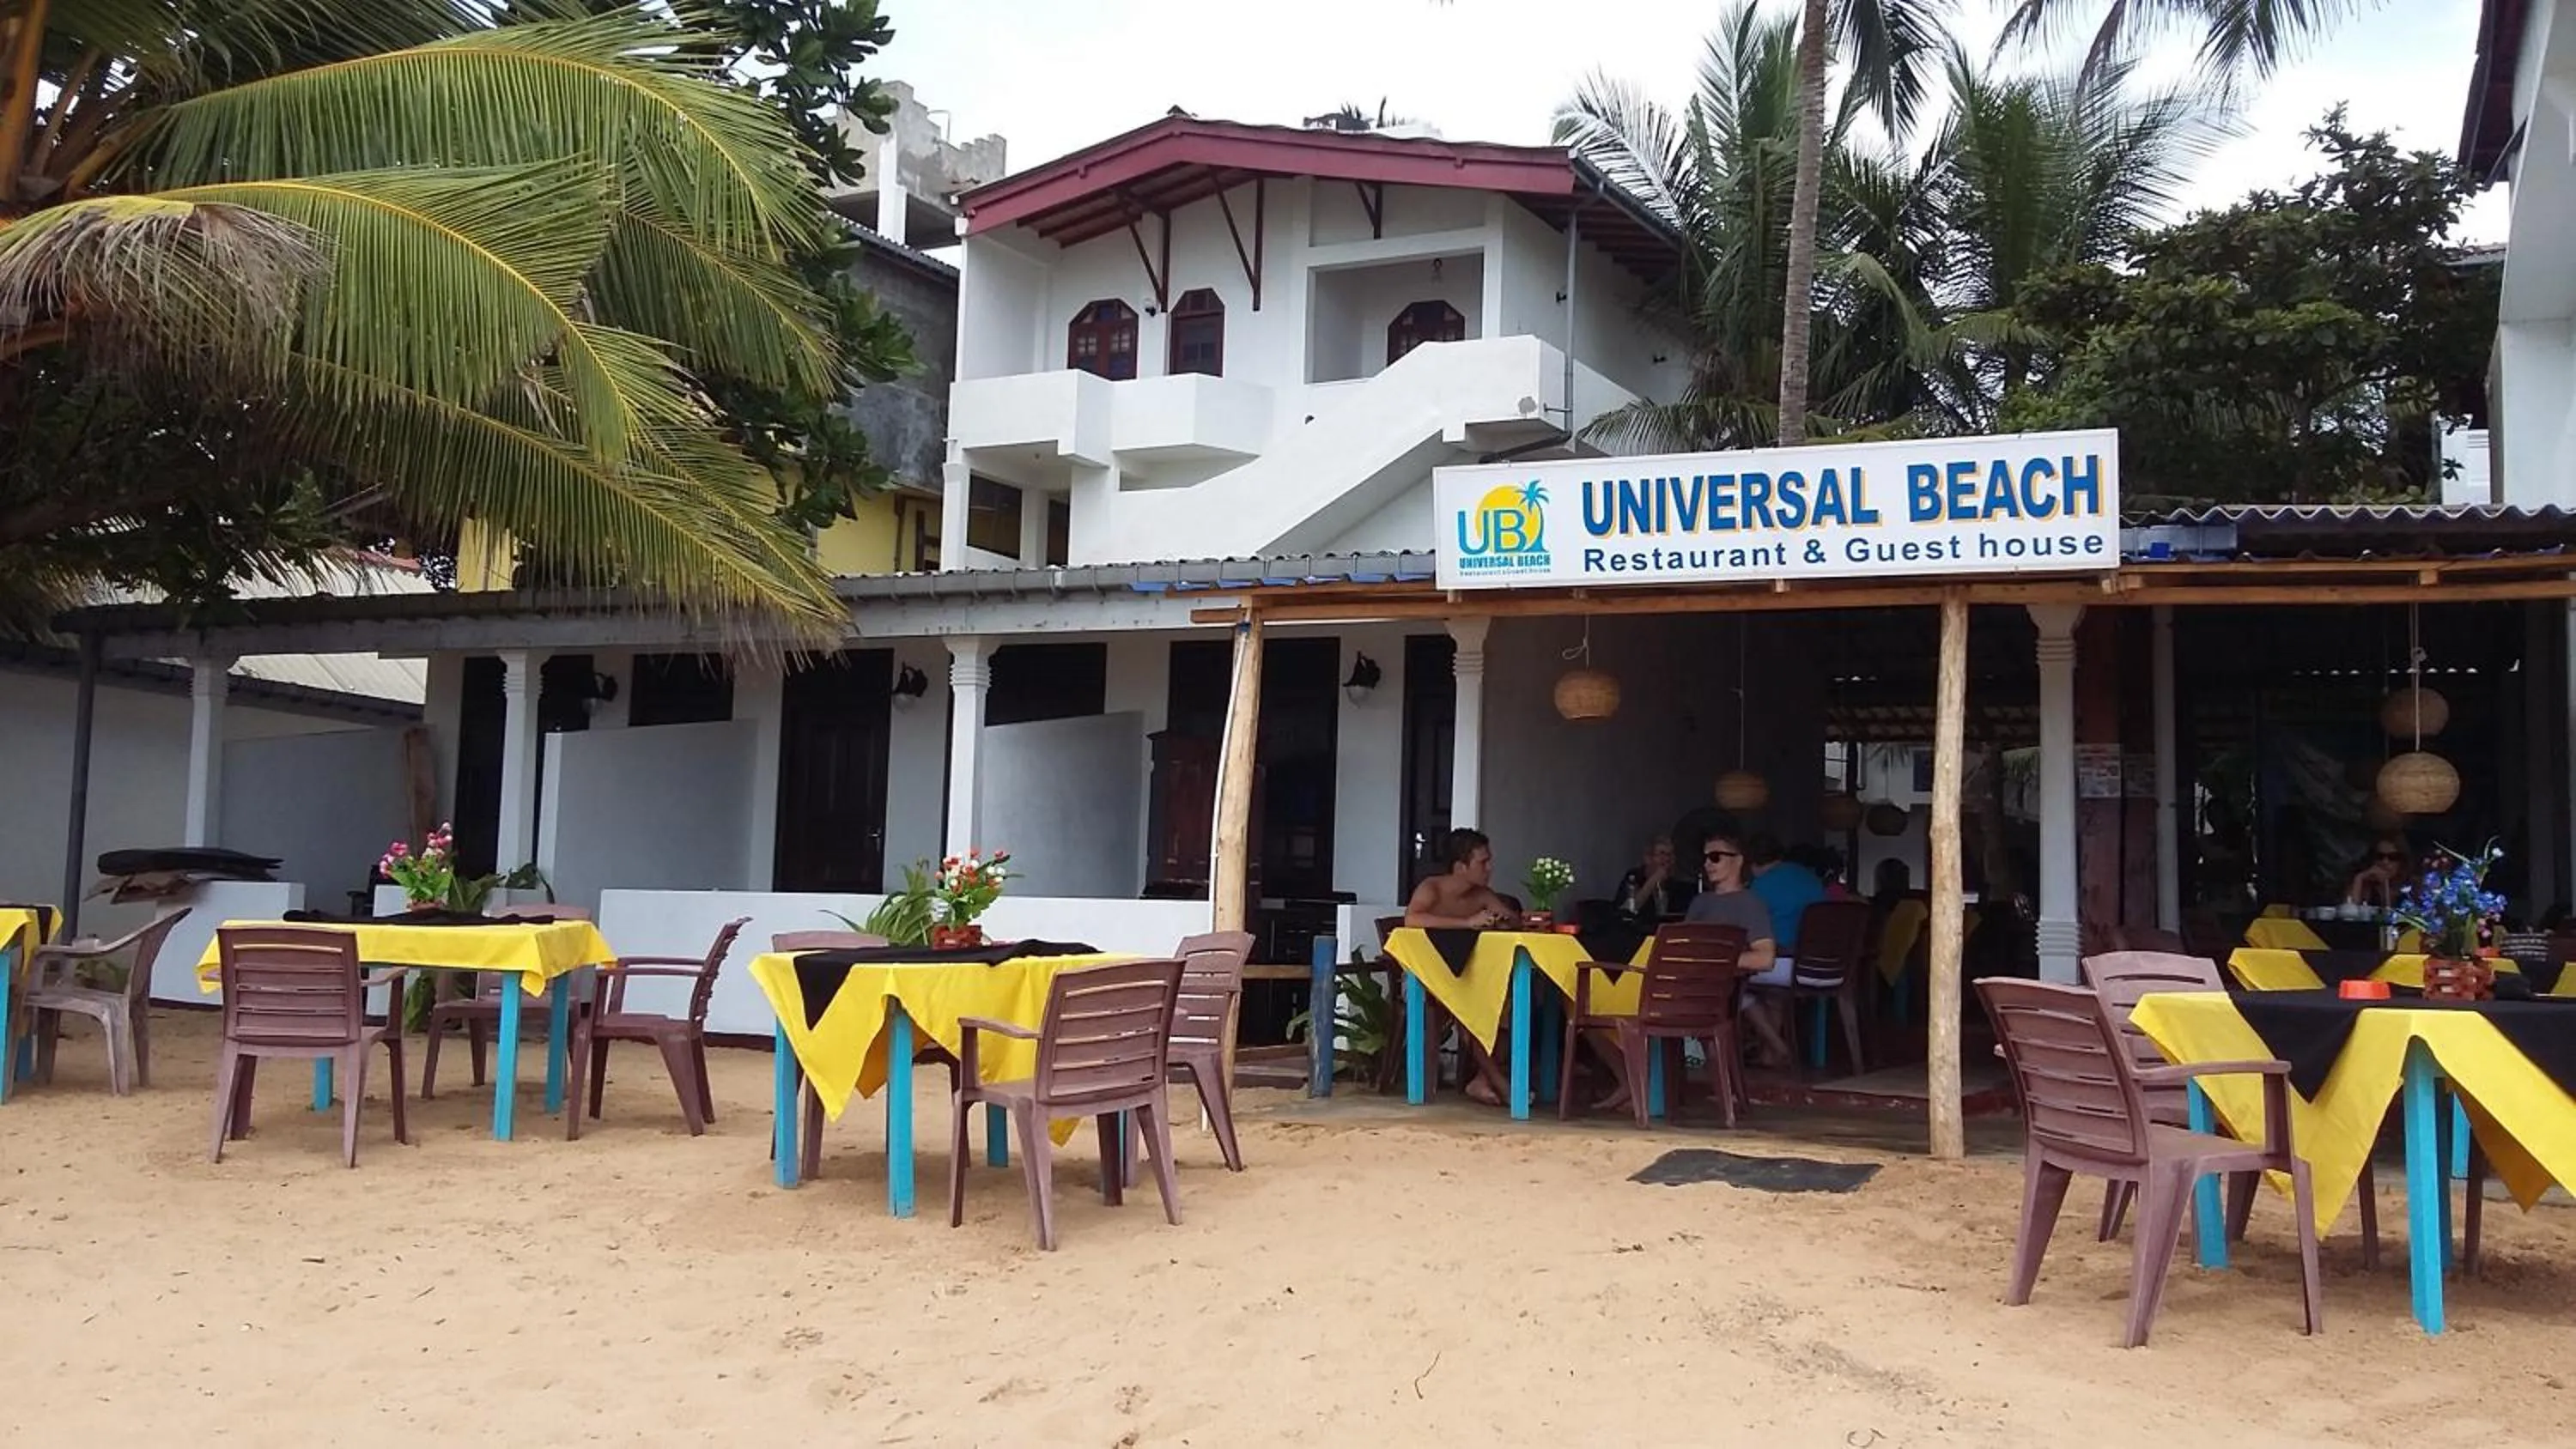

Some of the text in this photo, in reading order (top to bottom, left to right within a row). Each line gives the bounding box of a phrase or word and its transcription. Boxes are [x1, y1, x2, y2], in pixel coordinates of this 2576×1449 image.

[1583, 454, 2102, 539] UNIVERSAL BEACH
[1458, 509, 1527, 555] UB
[1584, 532, 2103, 572] Restaurant & Guest house
[1460, 554, 1551, 568] UNIVERSAL BEACH
